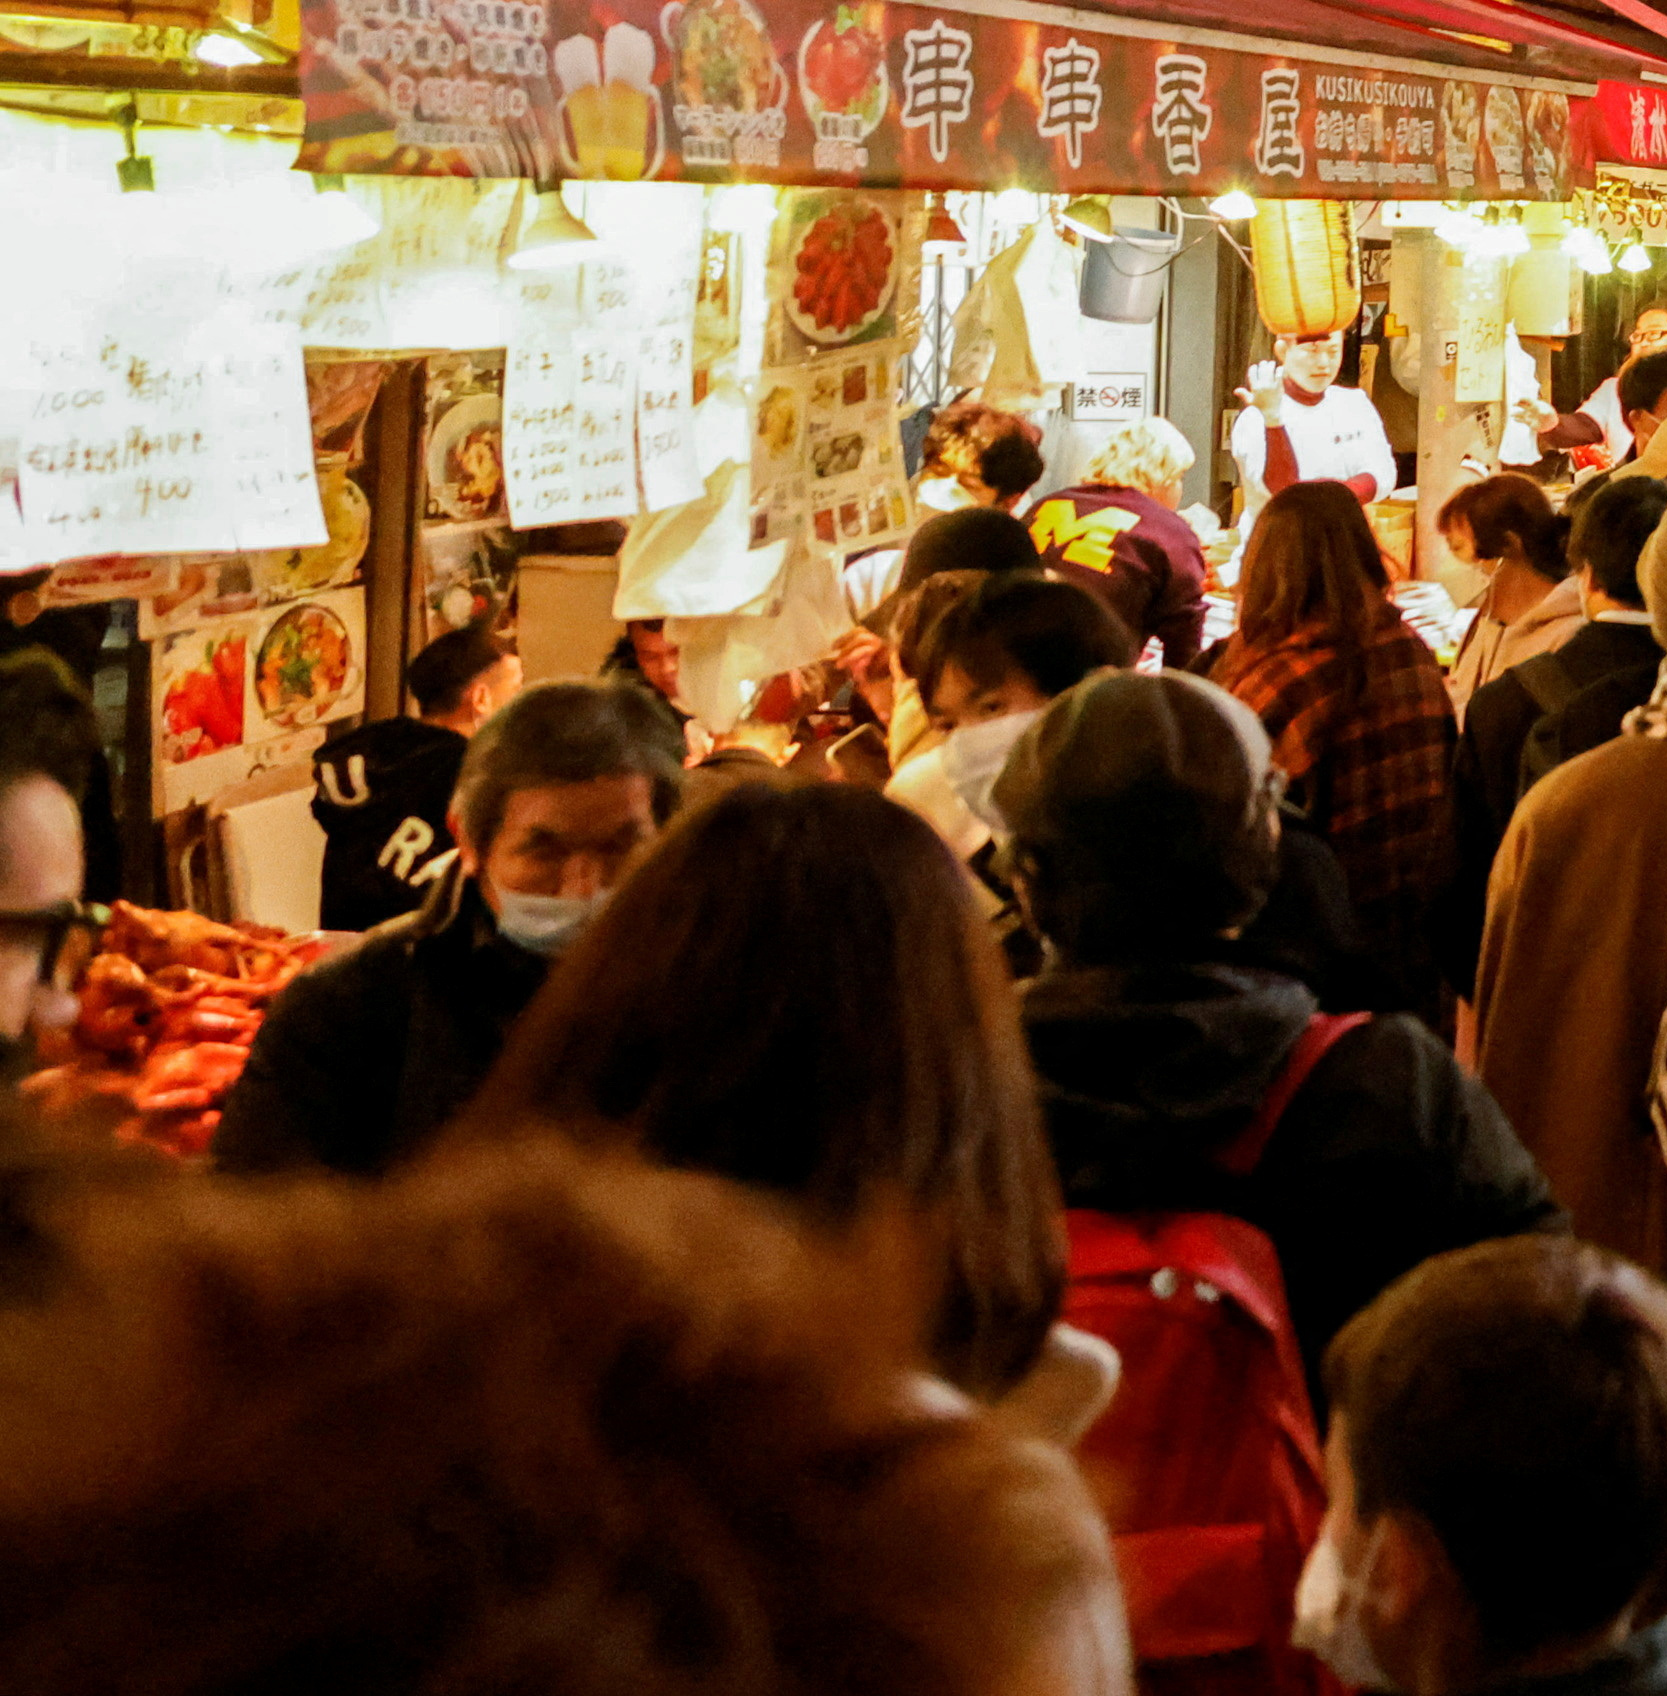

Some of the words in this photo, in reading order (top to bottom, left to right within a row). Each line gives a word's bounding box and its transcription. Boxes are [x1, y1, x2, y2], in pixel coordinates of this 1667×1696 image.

[901, 18, 1305, 179] 串串香屋
[1315, 74, 1435, 109] KUSIKUSIKOUYA
